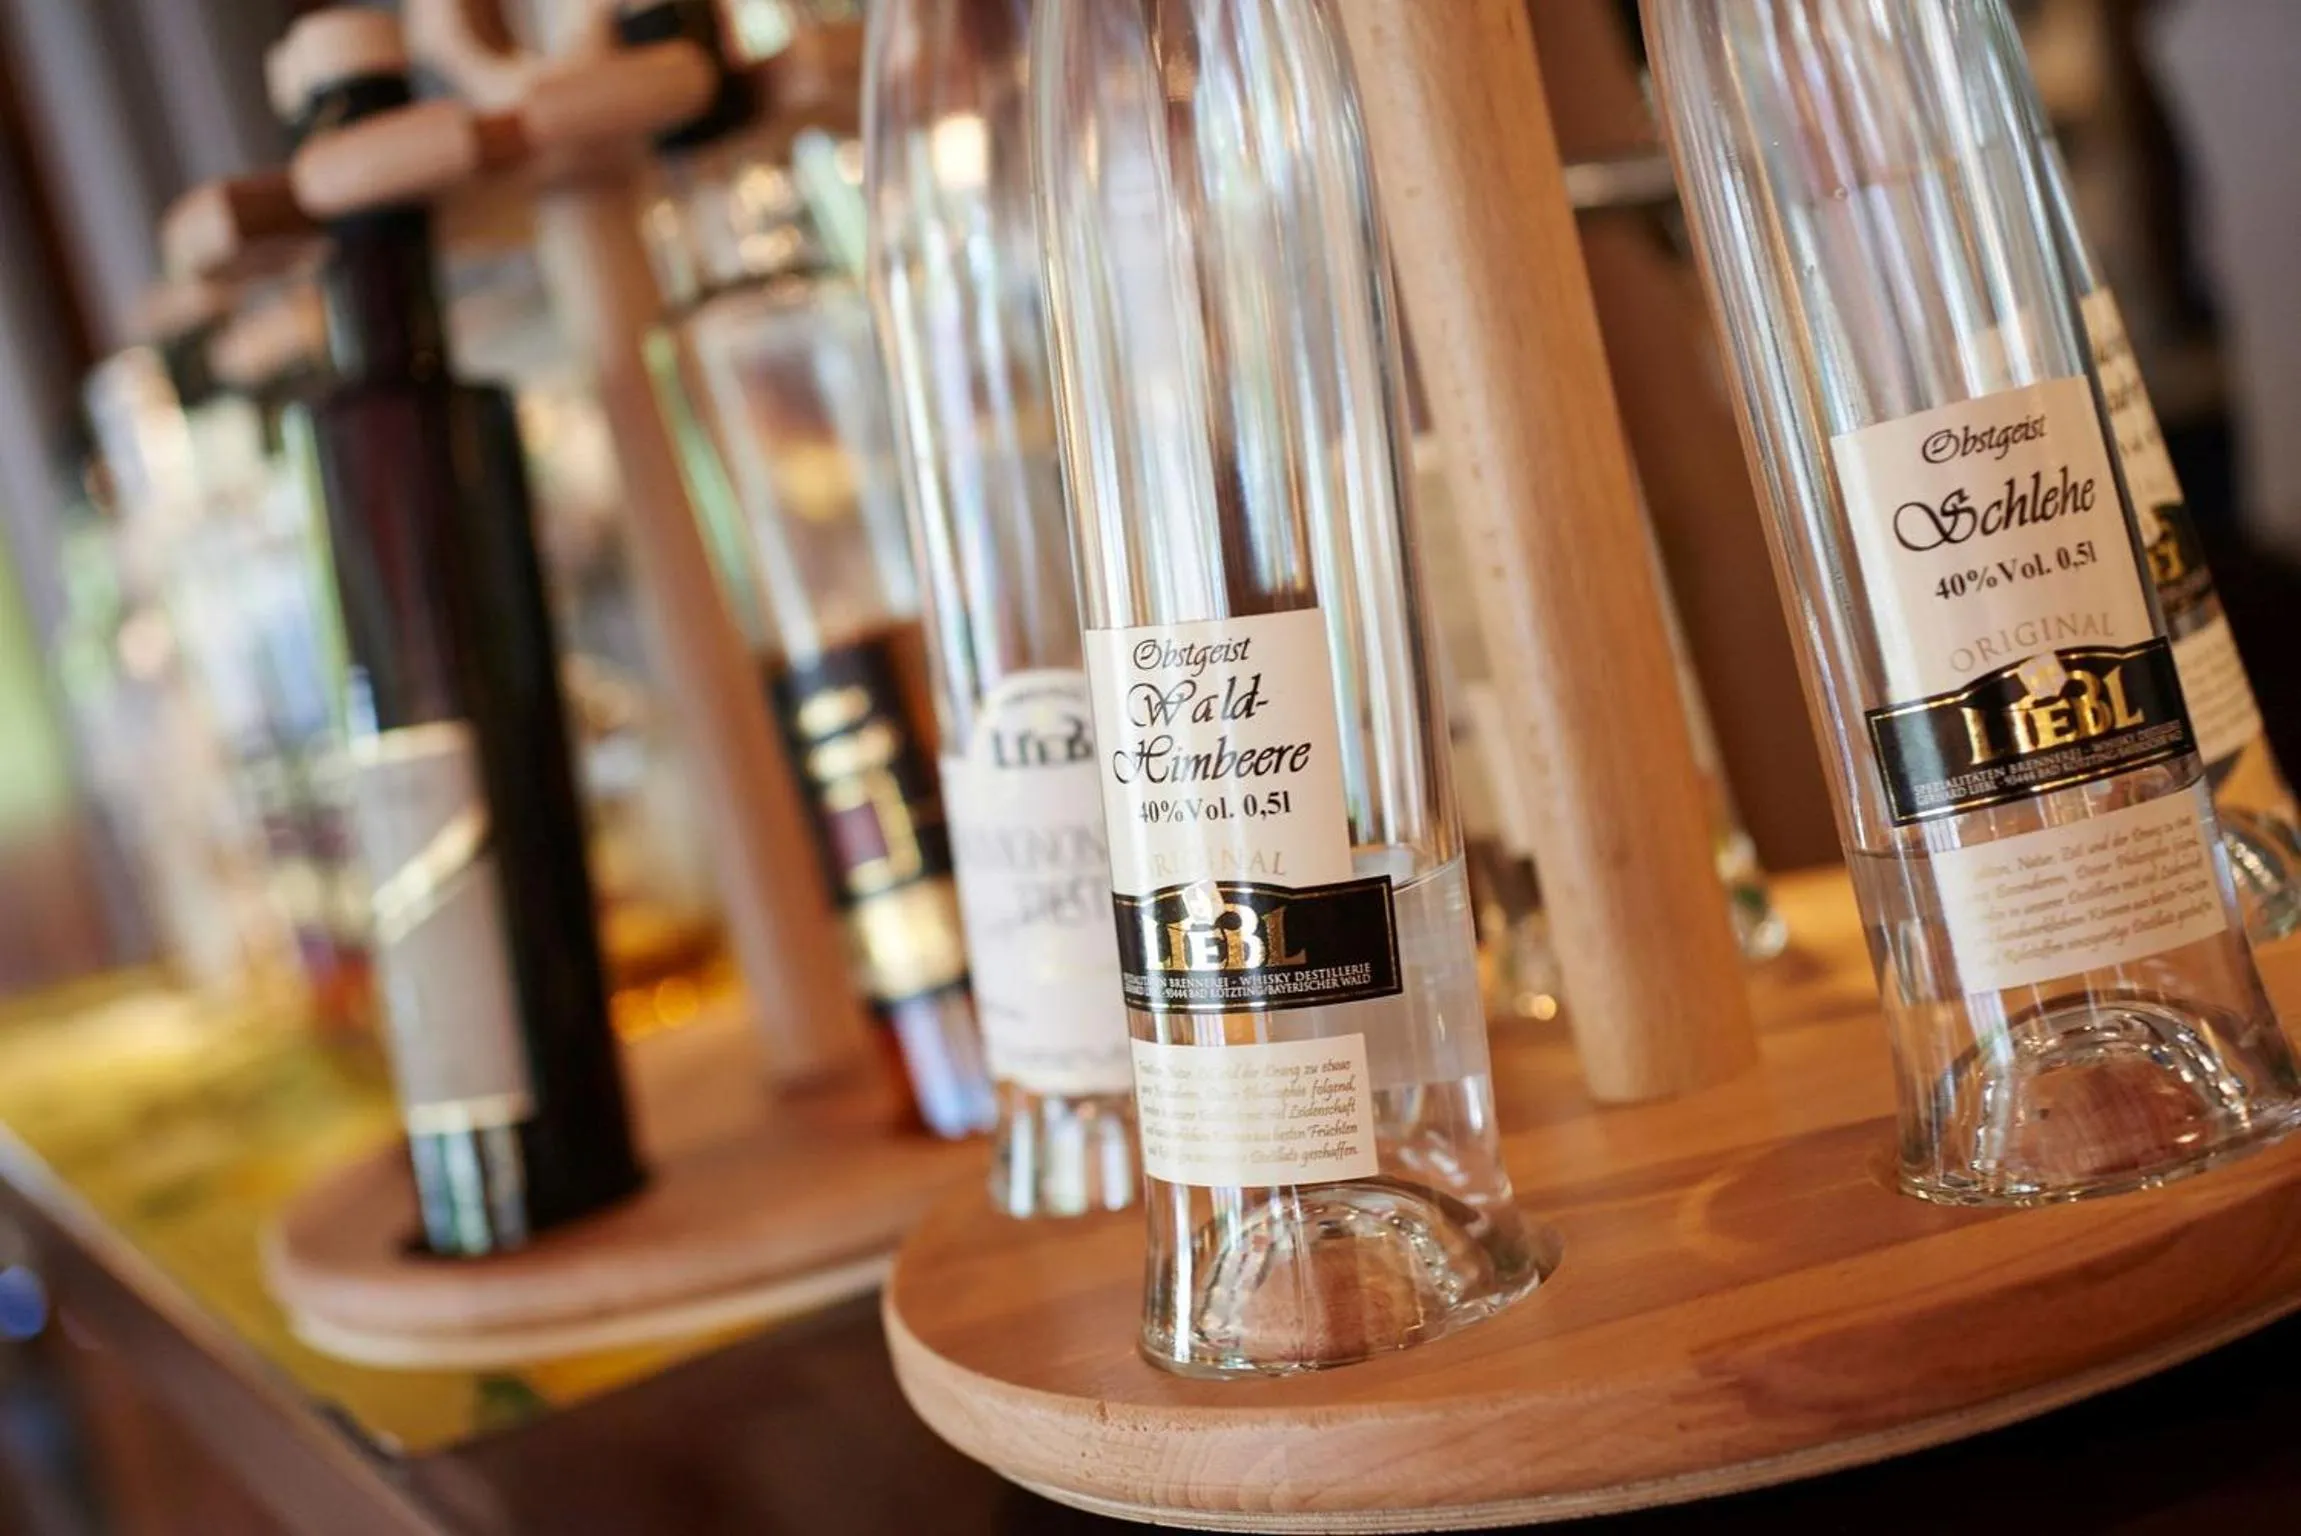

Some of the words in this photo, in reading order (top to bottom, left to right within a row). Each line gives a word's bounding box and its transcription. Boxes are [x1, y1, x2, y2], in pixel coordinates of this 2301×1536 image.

[1922, 413, 2047, 463] Obstgeist
[1893, 465, 2095, 552] Schlehe
[1133, 637, 1252, 677] Obstgeist
[1950, 612, 2114, 673] ORIGINAL
[1128, 673, 1269, 728] Wald-
[1113, 734, 1312, 785] Himbeere
[1243, 790, 1292, 821] 0,5l
[1140, 902, 1307, 971] LIEBL
[1239, 971, 1292, 987] WHISKY
[1294, 962, 1372, 982] DESTILLERIE
[1342, 973, 1372, 987] WALD
